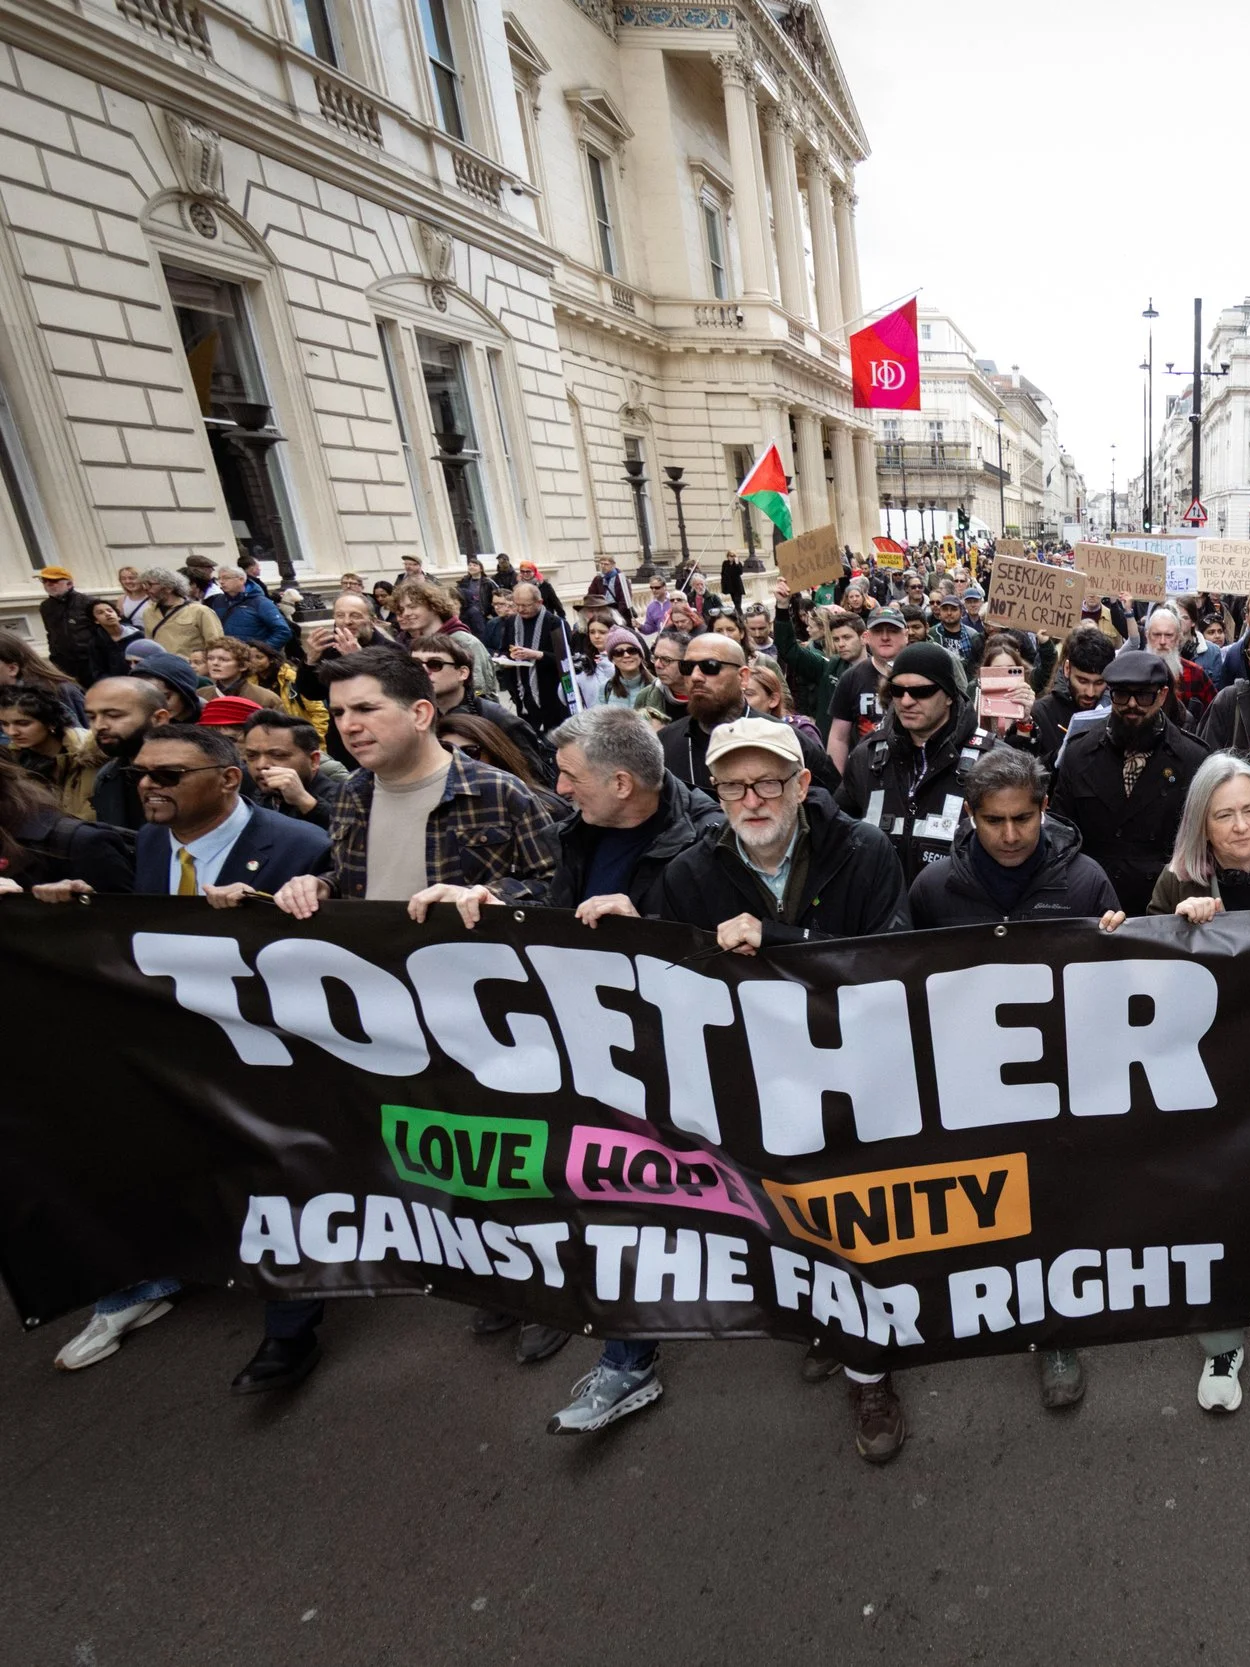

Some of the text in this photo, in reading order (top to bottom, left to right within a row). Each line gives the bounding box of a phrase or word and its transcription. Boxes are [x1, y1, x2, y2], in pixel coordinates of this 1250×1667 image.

[797, 536, 817, 557] NO
[1200, 540, 1220, 553] THE
[1200, 555, 1236, 566] ARRIVE
[1202, 567, 1226, 578] THEY
[997, 563, 1056, 590] SEEKING
[1111, 578, 1132, 593] DICK
[995, 582, 1073, 609] ASYLUM IS
[989, 597, 1075, 628] NOT A CRIME
[132, 931, 1219, 1156] TOGETHER
[394, 1124, 533, 1191] LOVE
[789, 1169, 1009, 1250] UNITY
[240, 1193, 1225, 1347] AGAINST THE FAR RIGHT
